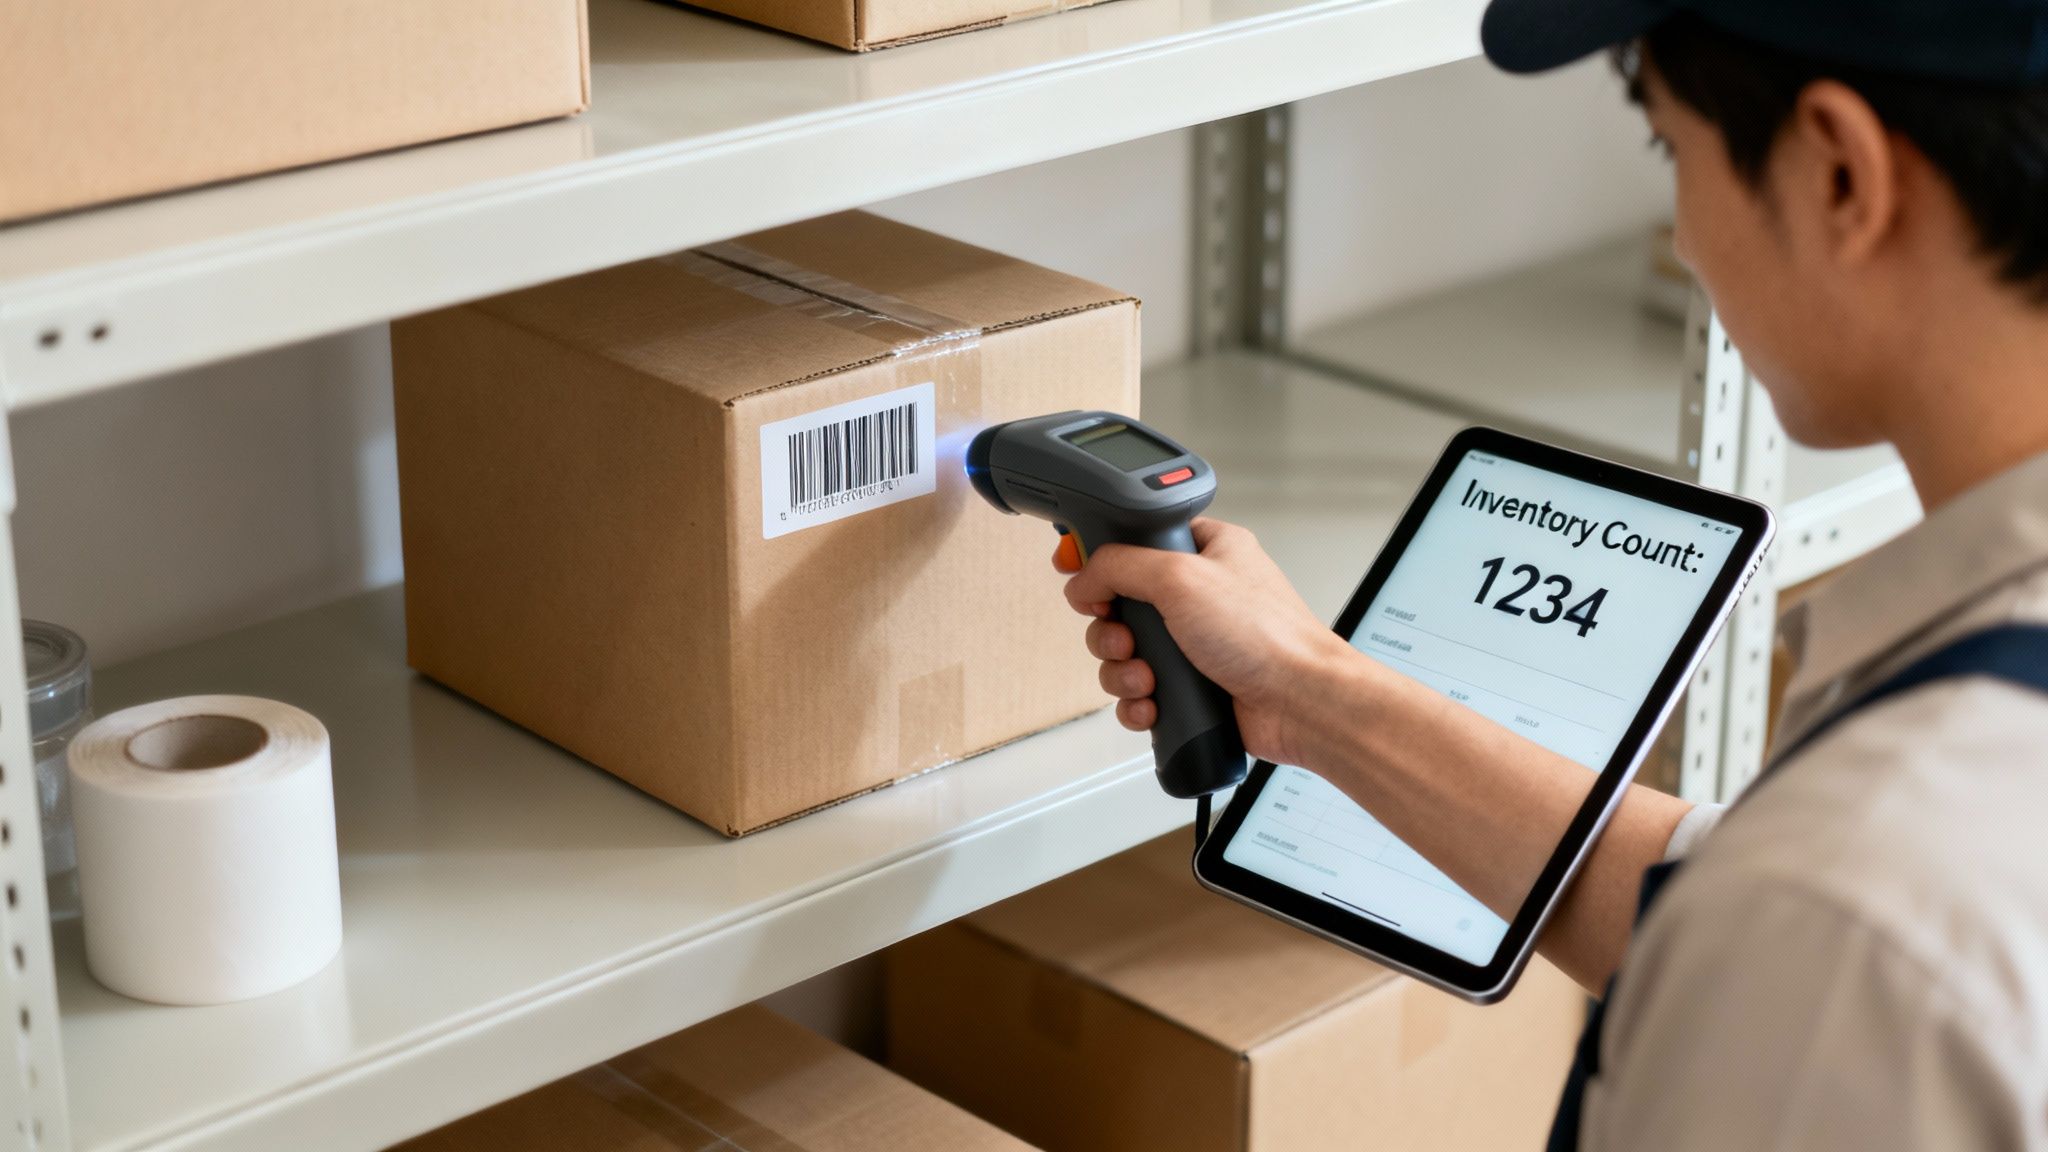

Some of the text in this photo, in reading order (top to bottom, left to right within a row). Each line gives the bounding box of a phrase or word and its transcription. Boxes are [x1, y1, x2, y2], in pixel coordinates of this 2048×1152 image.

[1461, 479, 1704, 574] Inventory Count:
[1474, 557, 1609, 638] 1234
